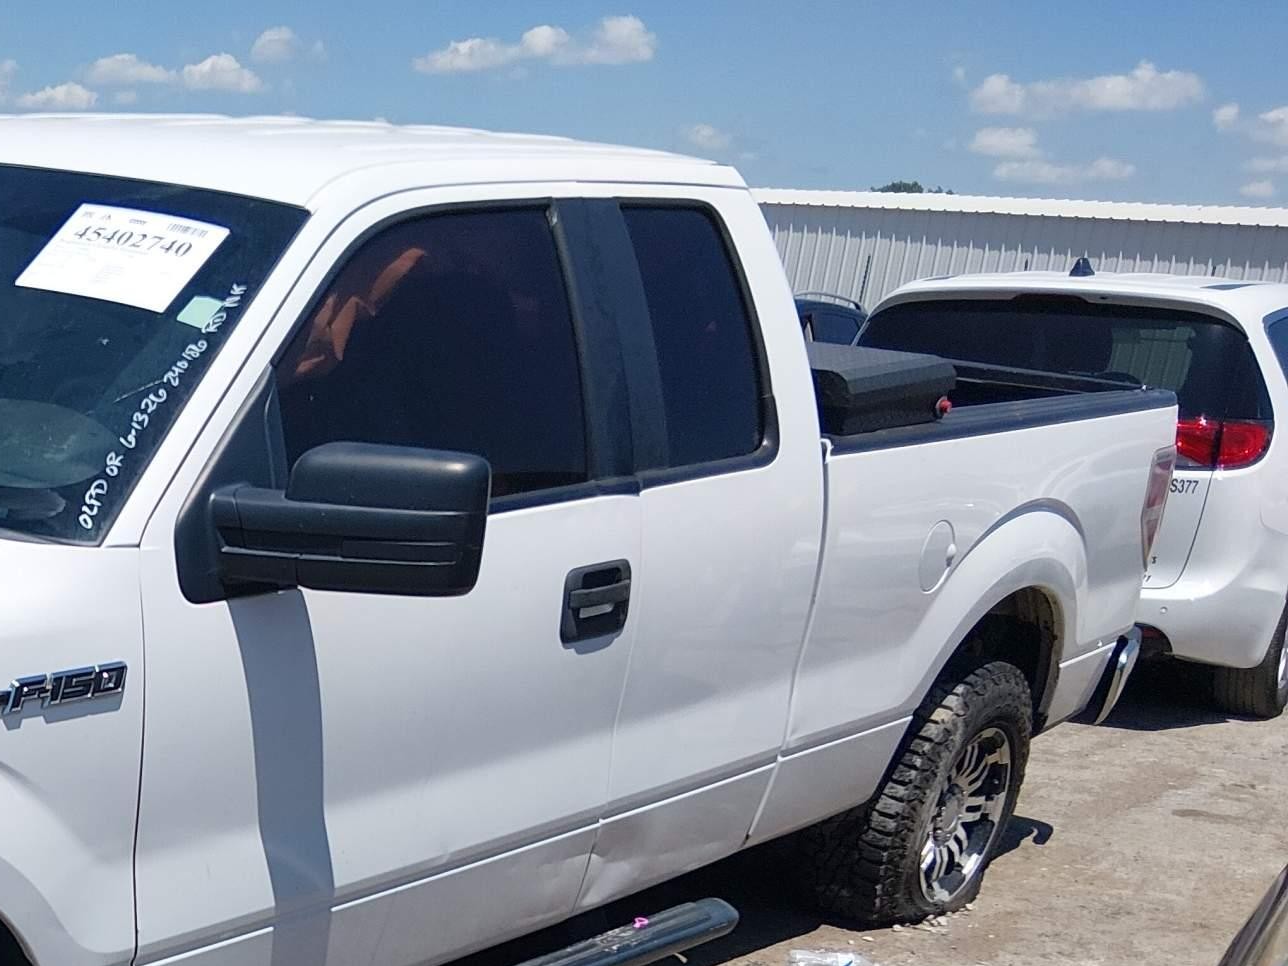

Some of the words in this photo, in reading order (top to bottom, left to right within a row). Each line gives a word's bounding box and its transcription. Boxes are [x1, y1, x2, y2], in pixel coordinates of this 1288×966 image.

[73, 224, 193, 258] 45402740
[1169, 478, 1199, 494] S377
[9, 661, 128, 713] F-150
